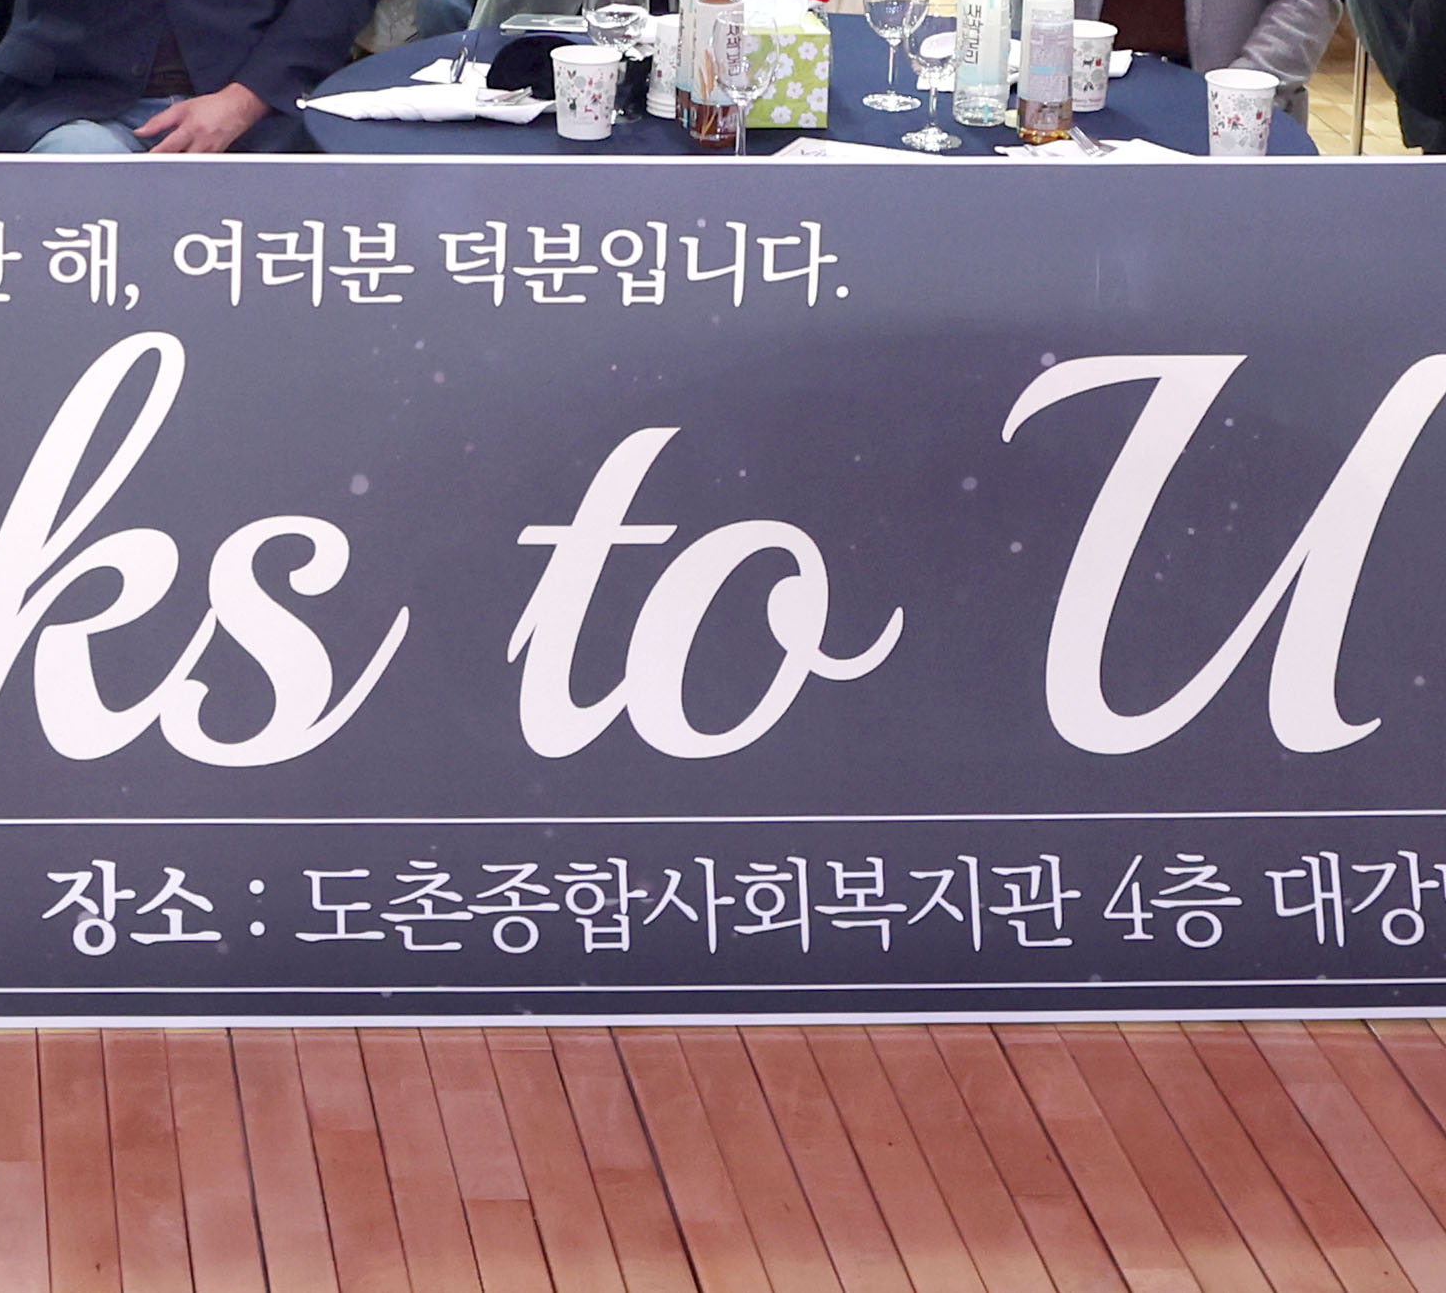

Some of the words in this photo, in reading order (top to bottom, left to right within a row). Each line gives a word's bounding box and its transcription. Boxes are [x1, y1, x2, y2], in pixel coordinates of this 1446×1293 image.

[42, 219, 140, 310] 해,
[174, 219, 414, 307] 여러분
[439, 221, 849, 307] 덕분입니다.
[508, 427, 904, 759] to
[41, 859, 222, 956] 장소
[296, 854, 1082, 954] 도촌종합사회복지관
[1104, 853, 1242, 948] 4층
